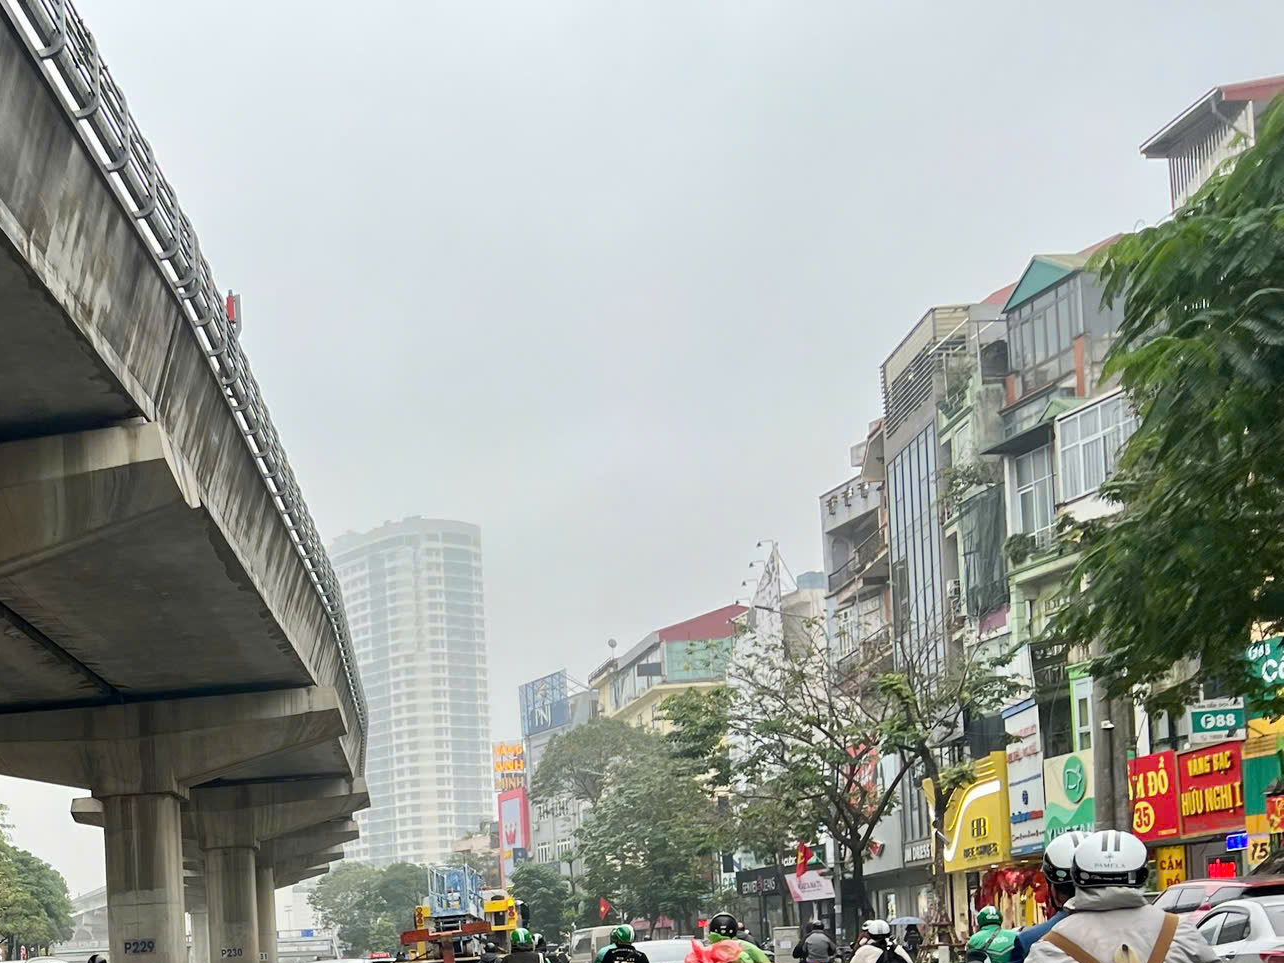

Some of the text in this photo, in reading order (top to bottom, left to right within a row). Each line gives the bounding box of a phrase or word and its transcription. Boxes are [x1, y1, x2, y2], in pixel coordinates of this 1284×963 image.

[1200, 713, 1236, 729] F88
[1134, 805, 1151, 829] 35
[913, 843, 931, 860] DRESS
[123, 940, 156, 955] P229
[221, 948, 243, 958] P230
